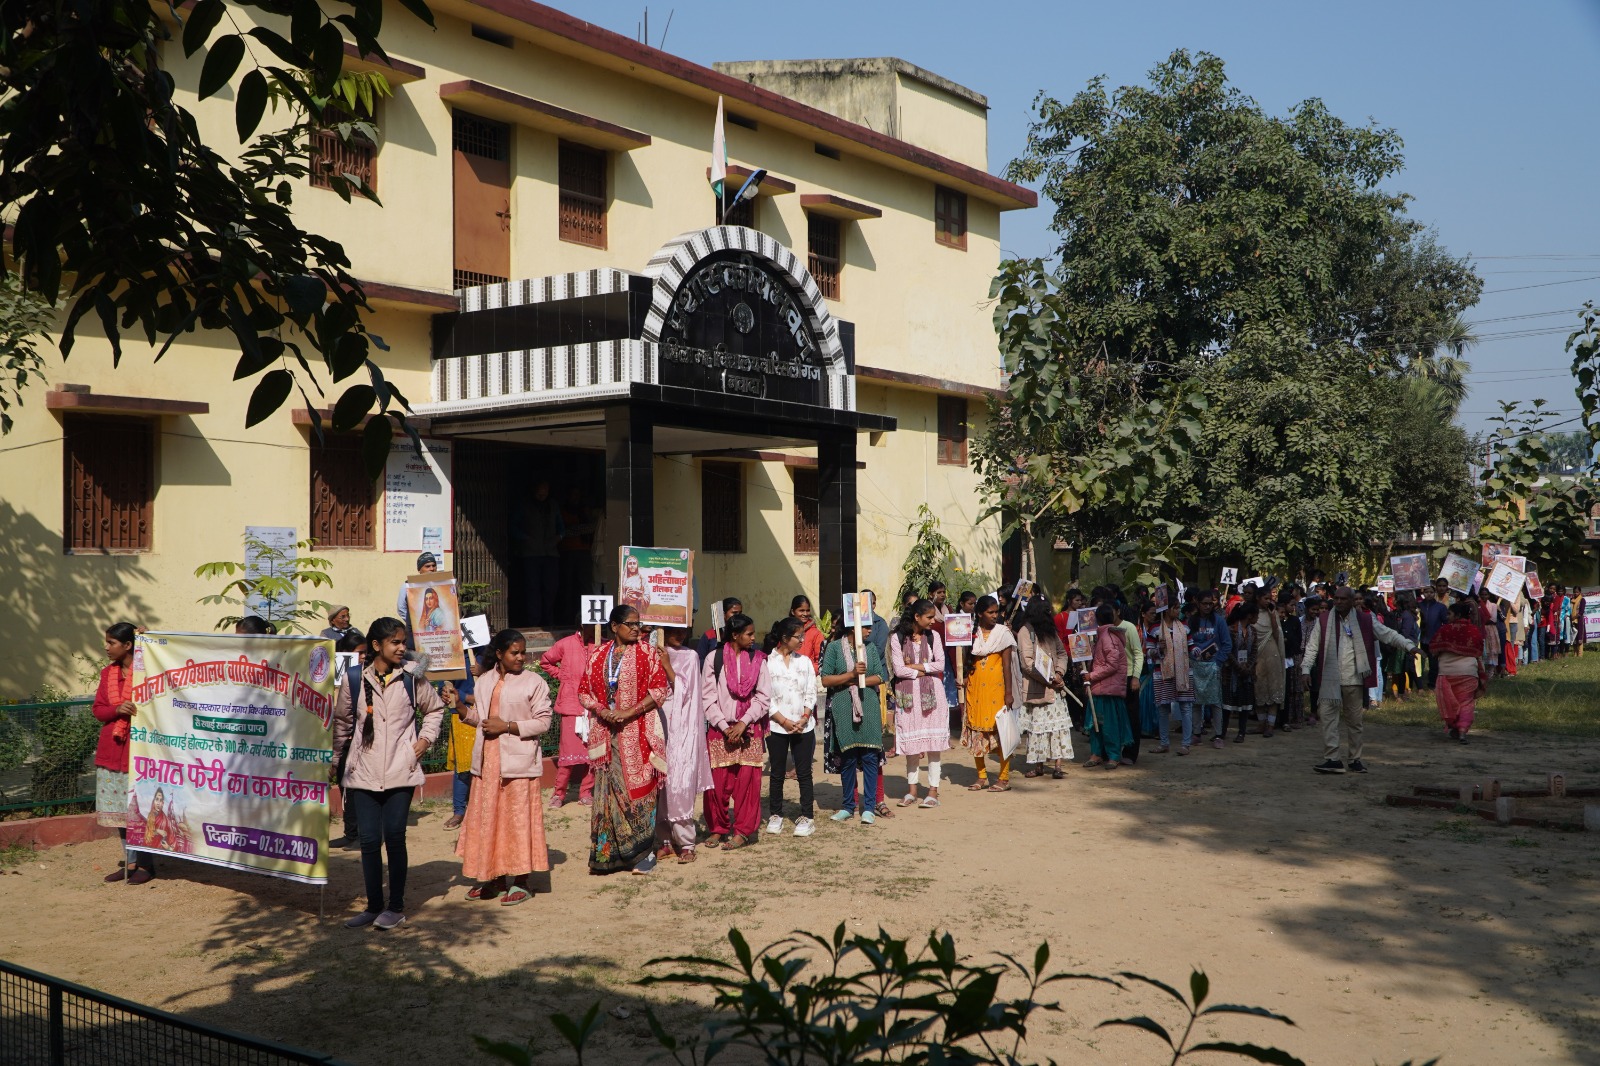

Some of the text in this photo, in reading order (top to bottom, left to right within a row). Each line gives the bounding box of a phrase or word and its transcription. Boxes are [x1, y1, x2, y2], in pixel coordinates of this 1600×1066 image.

[587, 599, 608, 622] H
[227, 654, 291, 696] वारिसलीगंज
[292, 671, 333, 730] (नवादा)
[198, 703, 221, 712] सरकार
[221, 703, 231, 713] एवं
[231, 705, 248, 715] मगध
[247, 724, 265, 733] प्राप्त
[187, 734, 214, 752] होल्कर
[214, 738, 223, 752] के
[277, 743, 288, 759] के
[289, 747, 318, 763] अवसर
[318, 749, 333, 764] पर
[134, 755, 327, 804] प्रभात फेरी का कार्यक्रम
[206, 825, 249, 847] दिनांक
[259, 834, 315, 860] 07.12.2024
